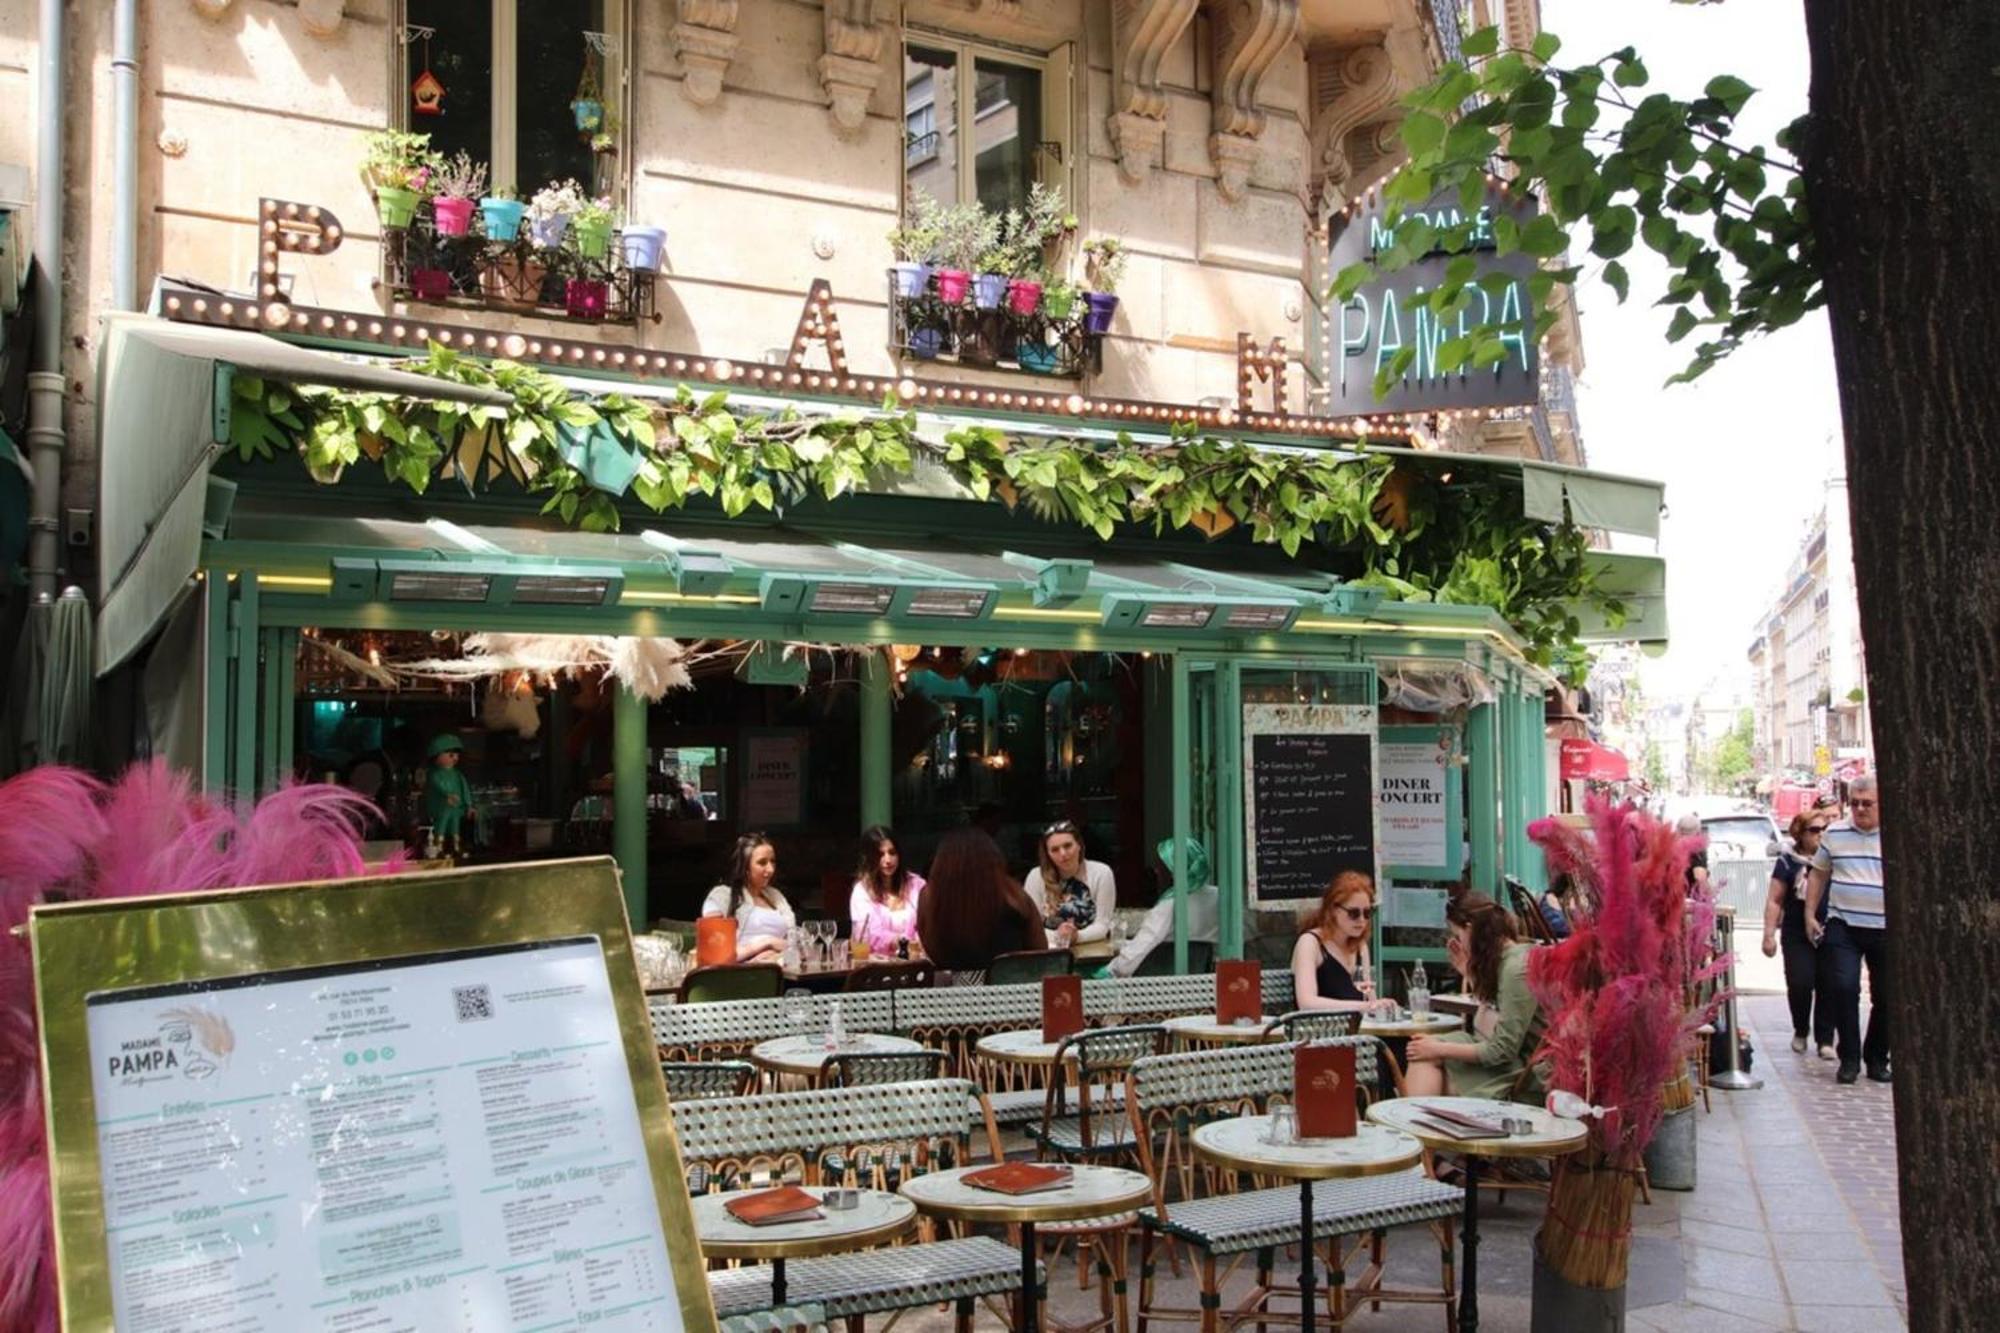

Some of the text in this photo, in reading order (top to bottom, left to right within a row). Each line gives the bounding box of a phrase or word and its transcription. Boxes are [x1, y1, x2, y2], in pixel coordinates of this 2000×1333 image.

[258, 198, 344, 302] P
[784, 278, 850, 375] A
[1340, 281, 1528, 385] PAMPA
[1238, 332, 1288, 415] M
[1380, 792, 1442, 804] ONCERT
[1382, 778, 1431, 790] DINER
[109, 1049, 179, 1077] PAMPA
